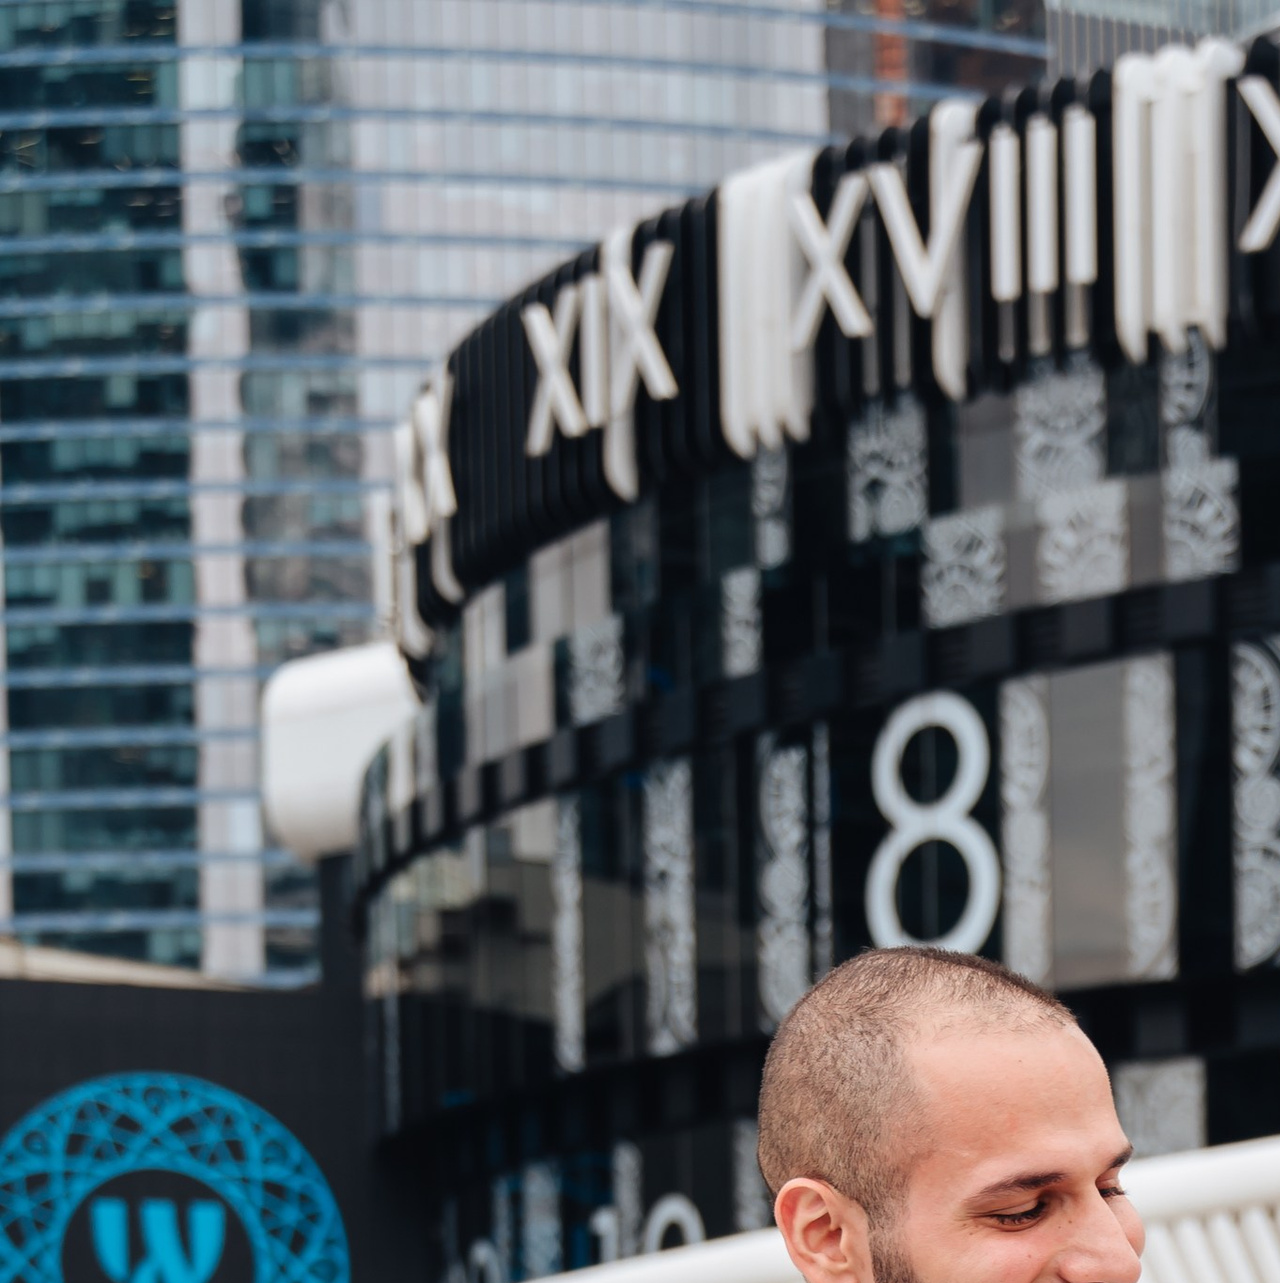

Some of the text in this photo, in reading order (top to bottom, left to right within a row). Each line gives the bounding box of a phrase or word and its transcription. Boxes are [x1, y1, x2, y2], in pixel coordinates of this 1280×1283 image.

[522, 240, 679, 458] XIX
[794, 103, 1098, 352] XVIII
[865, 690, 1001, 958] 8
